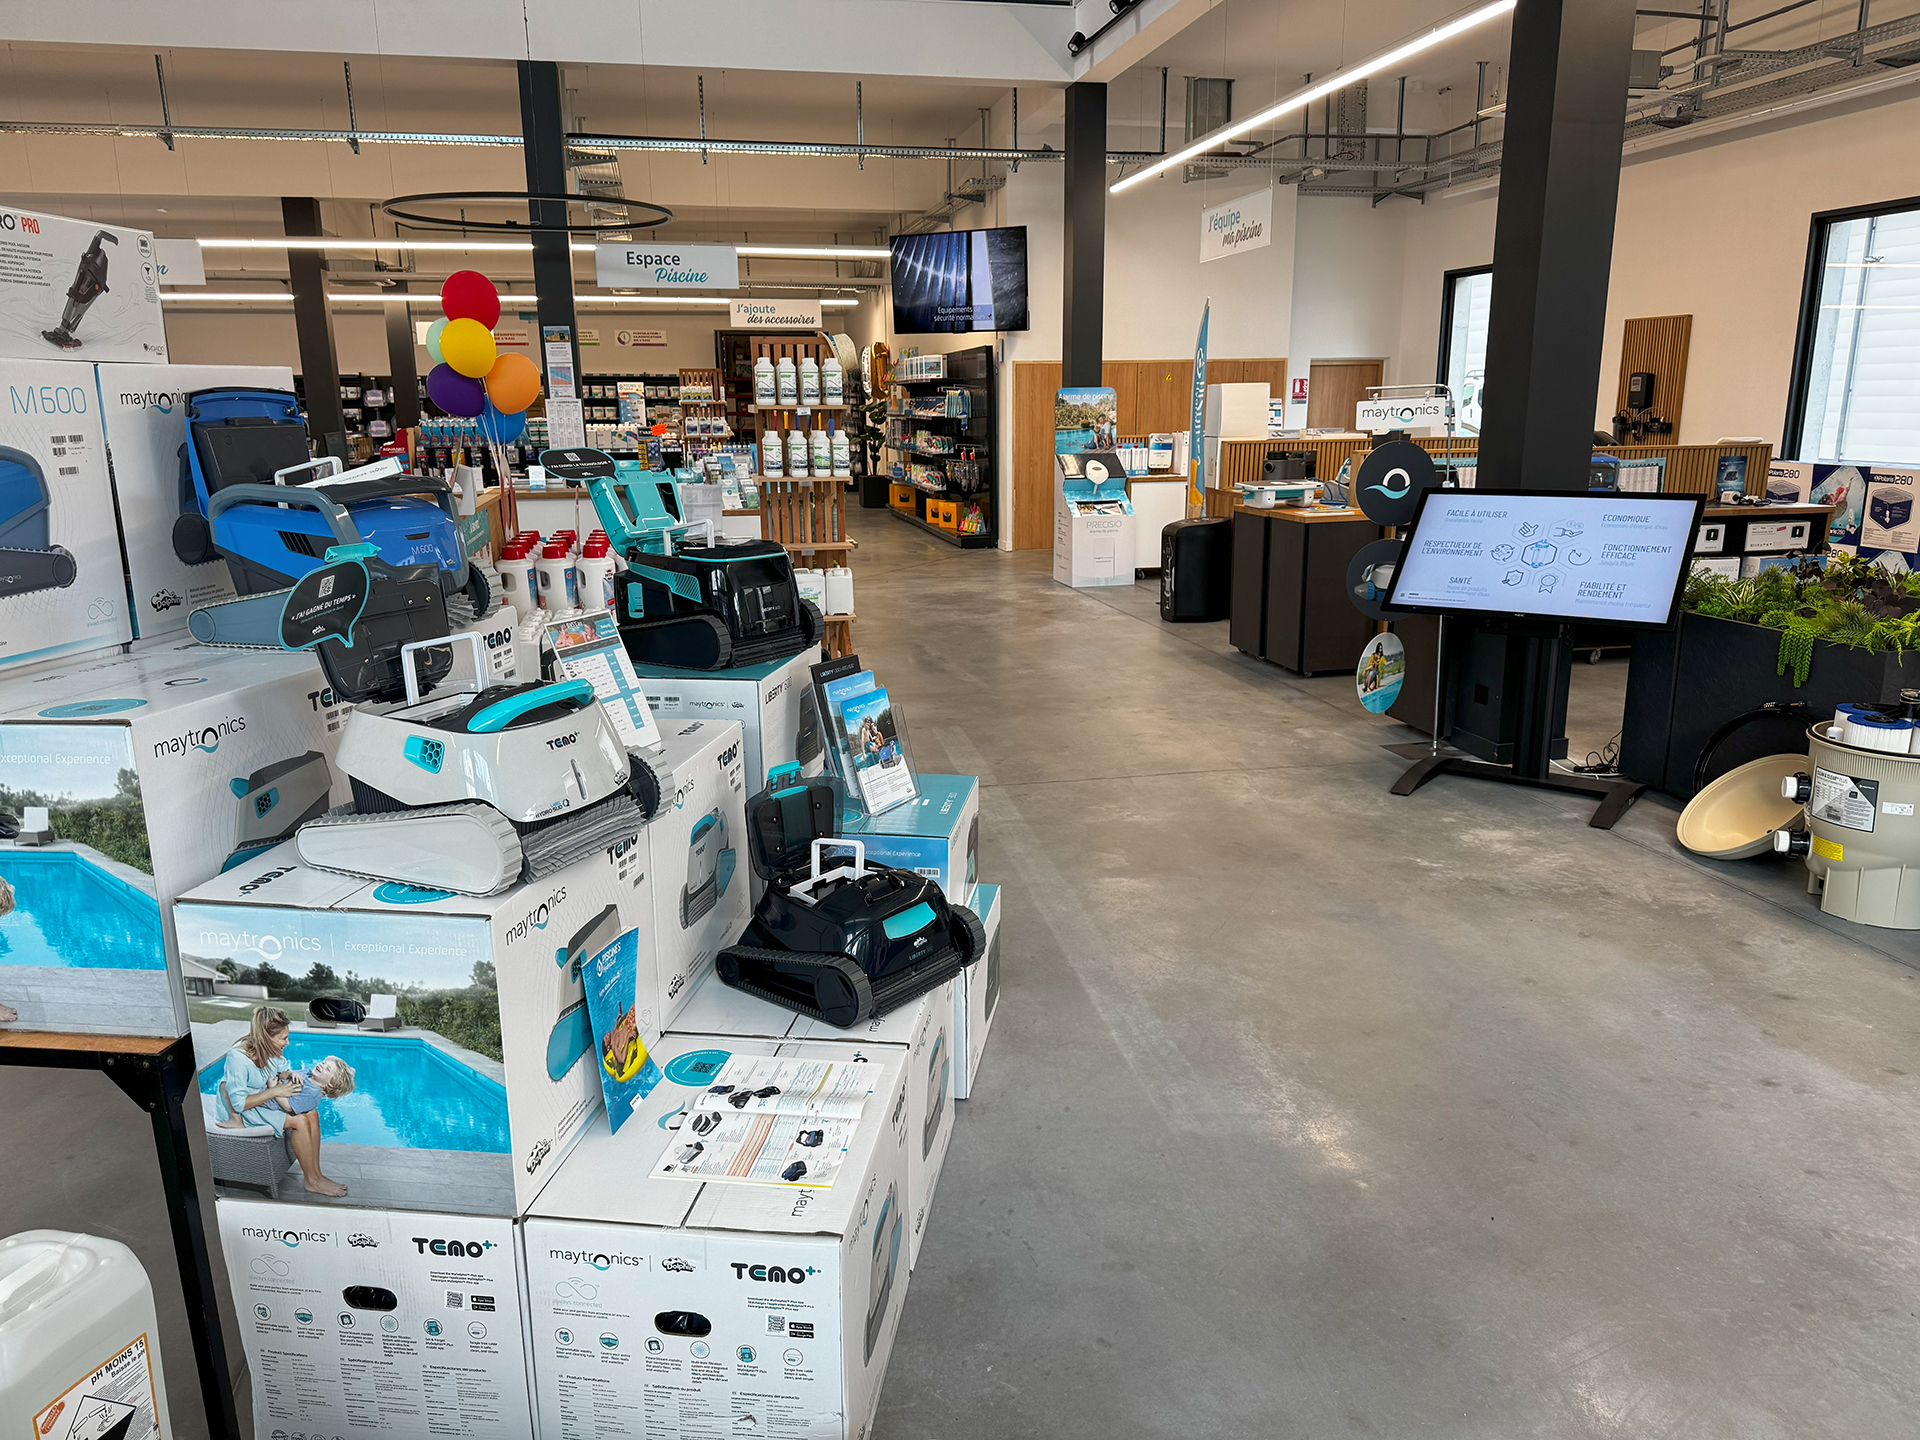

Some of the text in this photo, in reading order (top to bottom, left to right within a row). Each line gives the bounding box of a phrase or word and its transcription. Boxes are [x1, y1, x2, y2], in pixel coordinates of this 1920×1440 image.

[21, 217, 40, 234] PRO
[1208, 209, 1240, 233] J'équipe
[1222, 220, 1263, 248] ma piscine
[626, 251, 681, 268] Espace
[654, 268, 709, 283] Piscine
[736, 304, 776, 316] J'ajoute
[938, 306, 972, 314] Équipements
[747, 314, 816, 324] des accessoires
[10, 386, 87, 414] M600
[1362, 403, 1440, 422] maytronics
[1784, 470, 1800, 479] 280
[1895, 475, 1914, 485] 280
[1446, 508, 1508, 518] FACILE À UTILISER
[1602, 514, 1651, 523] ECONOMIQUE
[1086, 520, 1122, 528] PRECISIO
[411, 544, 434, 555] M600
[1424, 540, 1470, 549] RESPECTUEUX
[1603, 544, 1672, 554] FONCTIONNEMENT
[1422, 546, 1484, 557] L'ENVIRONNEMENT
[1601, 552, 1637, 560] EFFICACE
[1449, 576, 1472, 585] SANTÉ
[1580, 581, 1615, 590] FIABILITÉ
[1577, 589, 1623, 599] RENDEMENT
[306, 602, 324, 616] GAGNÉ
[324, 600, 332, 608] DU
[333, 594, 352, 605] TEMPS
[484, 626, 513, 650] TEMO
[308, 687, 345, 712] TE
[690, 701, 725, 709] maytronics
[154, 714, 246, 758] maytronics
[0, 753, 111, 765] xceptional Experience
[535, 804, 563, 818] HYDRO SUD
[505, 886, 567, 946] maytronics
[200, 930, 467, 957] maytronics Exceptional Experience
[242, 1225, 328, 1248] maytronics
[550, 1249, 640, 1270] maytronics
[90, 1340, 144, 1385] pH MOINS 15
[111, 1361, 130, 1378] Baisse
[137, 1349, 145, 1359] pH
